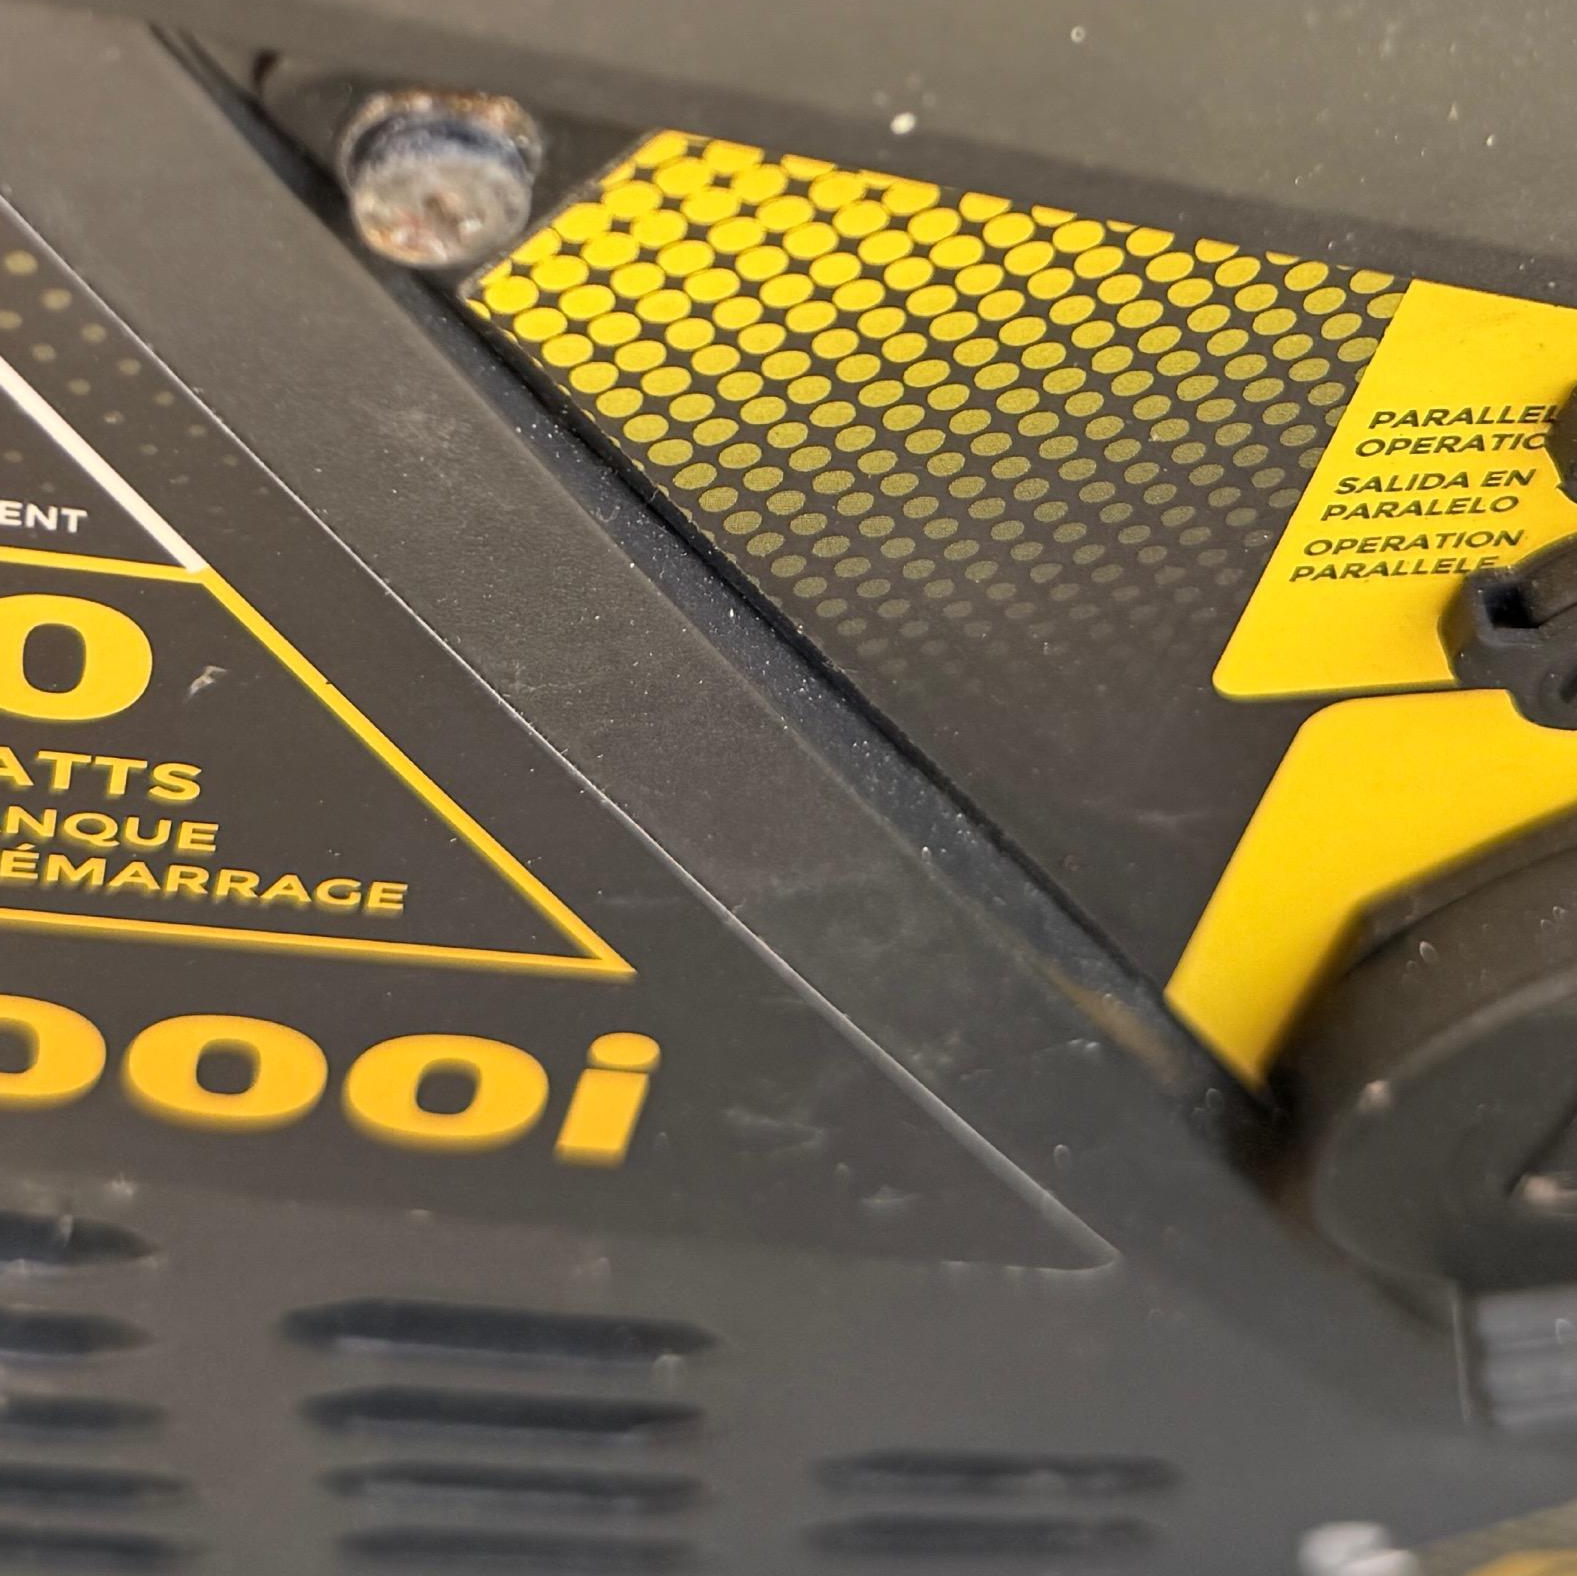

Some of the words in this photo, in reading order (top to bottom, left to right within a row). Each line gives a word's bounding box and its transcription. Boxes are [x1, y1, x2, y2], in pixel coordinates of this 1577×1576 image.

[1367, 403, 1558, 429] PARALLEL
[1354, 432, 1548, 458] OPERATIO
[1332, 470, 1470, 495] SALIDA
[1479, 468, 1537, 488] EN
[1319, 494, 1520, 522] PARALELO
[1302, 528, 1525, 557] OPERATION
[1288, 555, 1500, 583] PARALLELE
